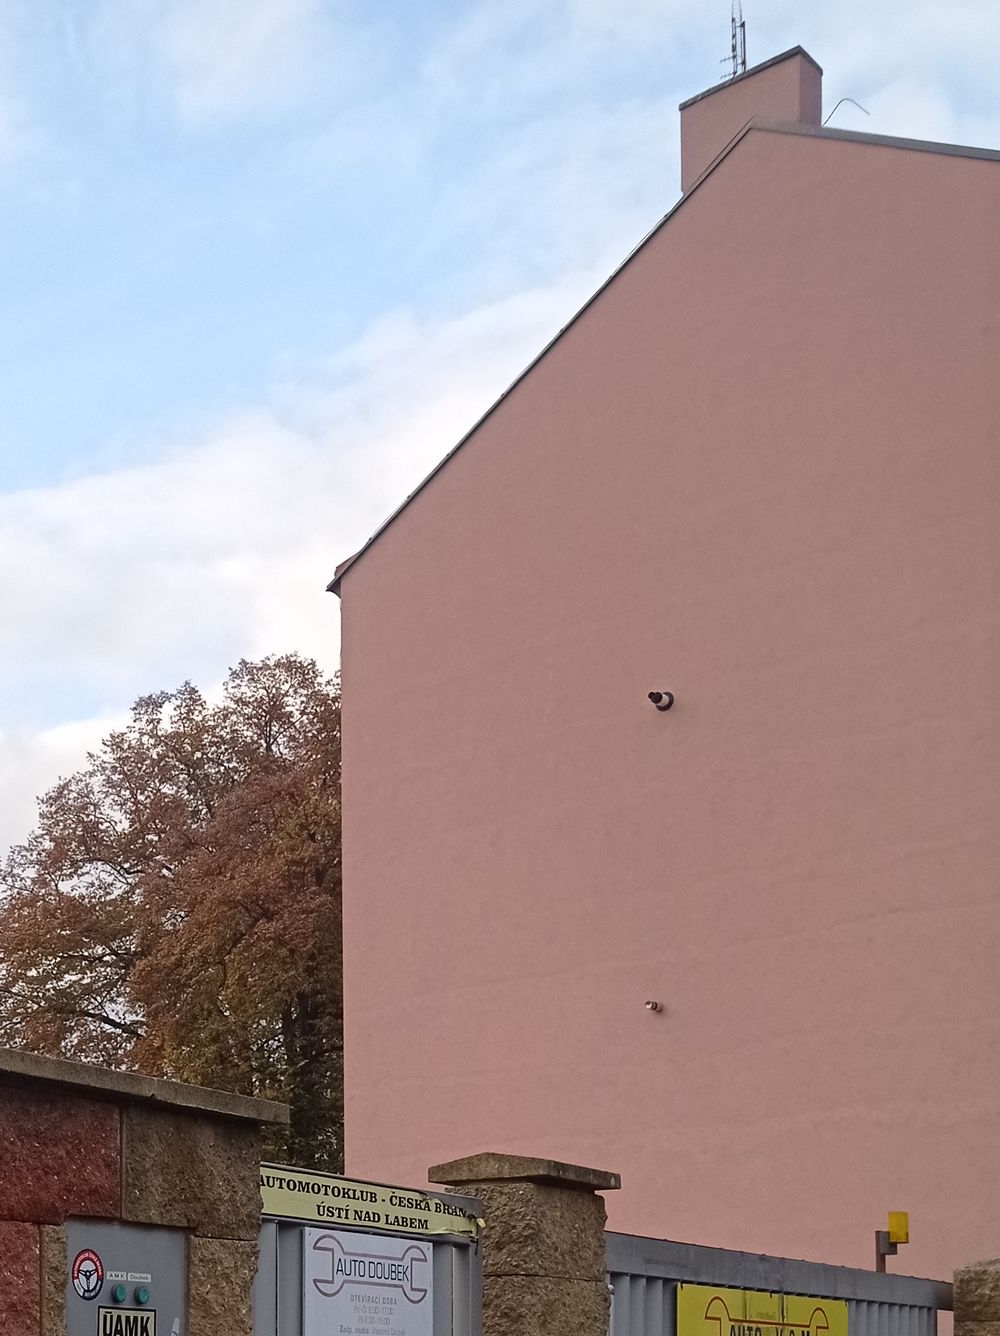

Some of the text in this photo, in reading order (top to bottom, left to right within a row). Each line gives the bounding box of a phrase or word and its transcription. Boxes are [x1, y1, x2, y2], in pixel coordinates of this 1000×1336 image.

[315, 1200, 429, 1231] ÚSTÍ NAD LABEM
[336, 1258, 410, 1282] AUTO DOUBEK
